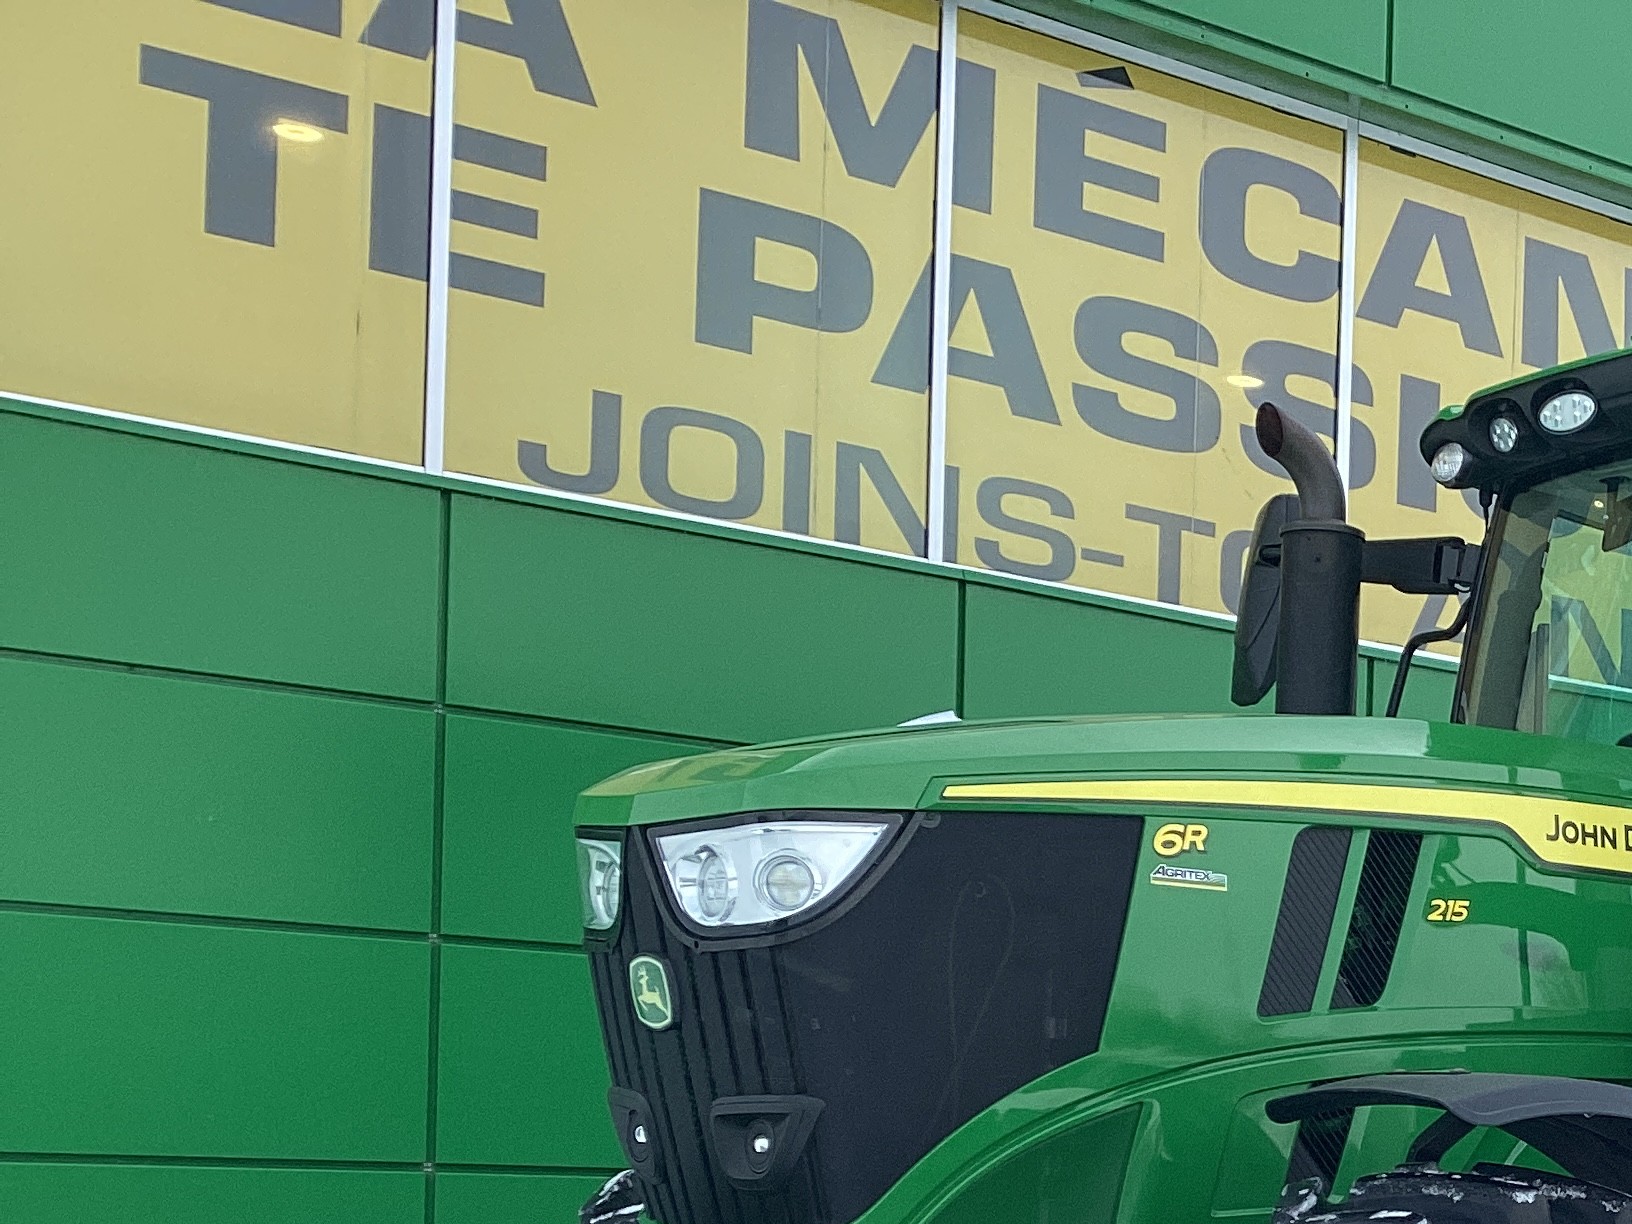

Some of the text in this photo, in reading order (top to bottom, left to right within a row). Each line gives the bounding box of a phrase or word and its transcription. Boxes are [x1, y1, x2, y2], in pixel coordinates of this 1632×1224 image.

[195, 0, 598, 108] A
[139, 43, 1490, 520] TE PASSI
[1152, 822, 1209, 857] 6R
[1546, 814, 1618, 850] JOHN
[1153, 865, 1211, 881] AGRITEX
[1426, 898, 1471, 923] 215
